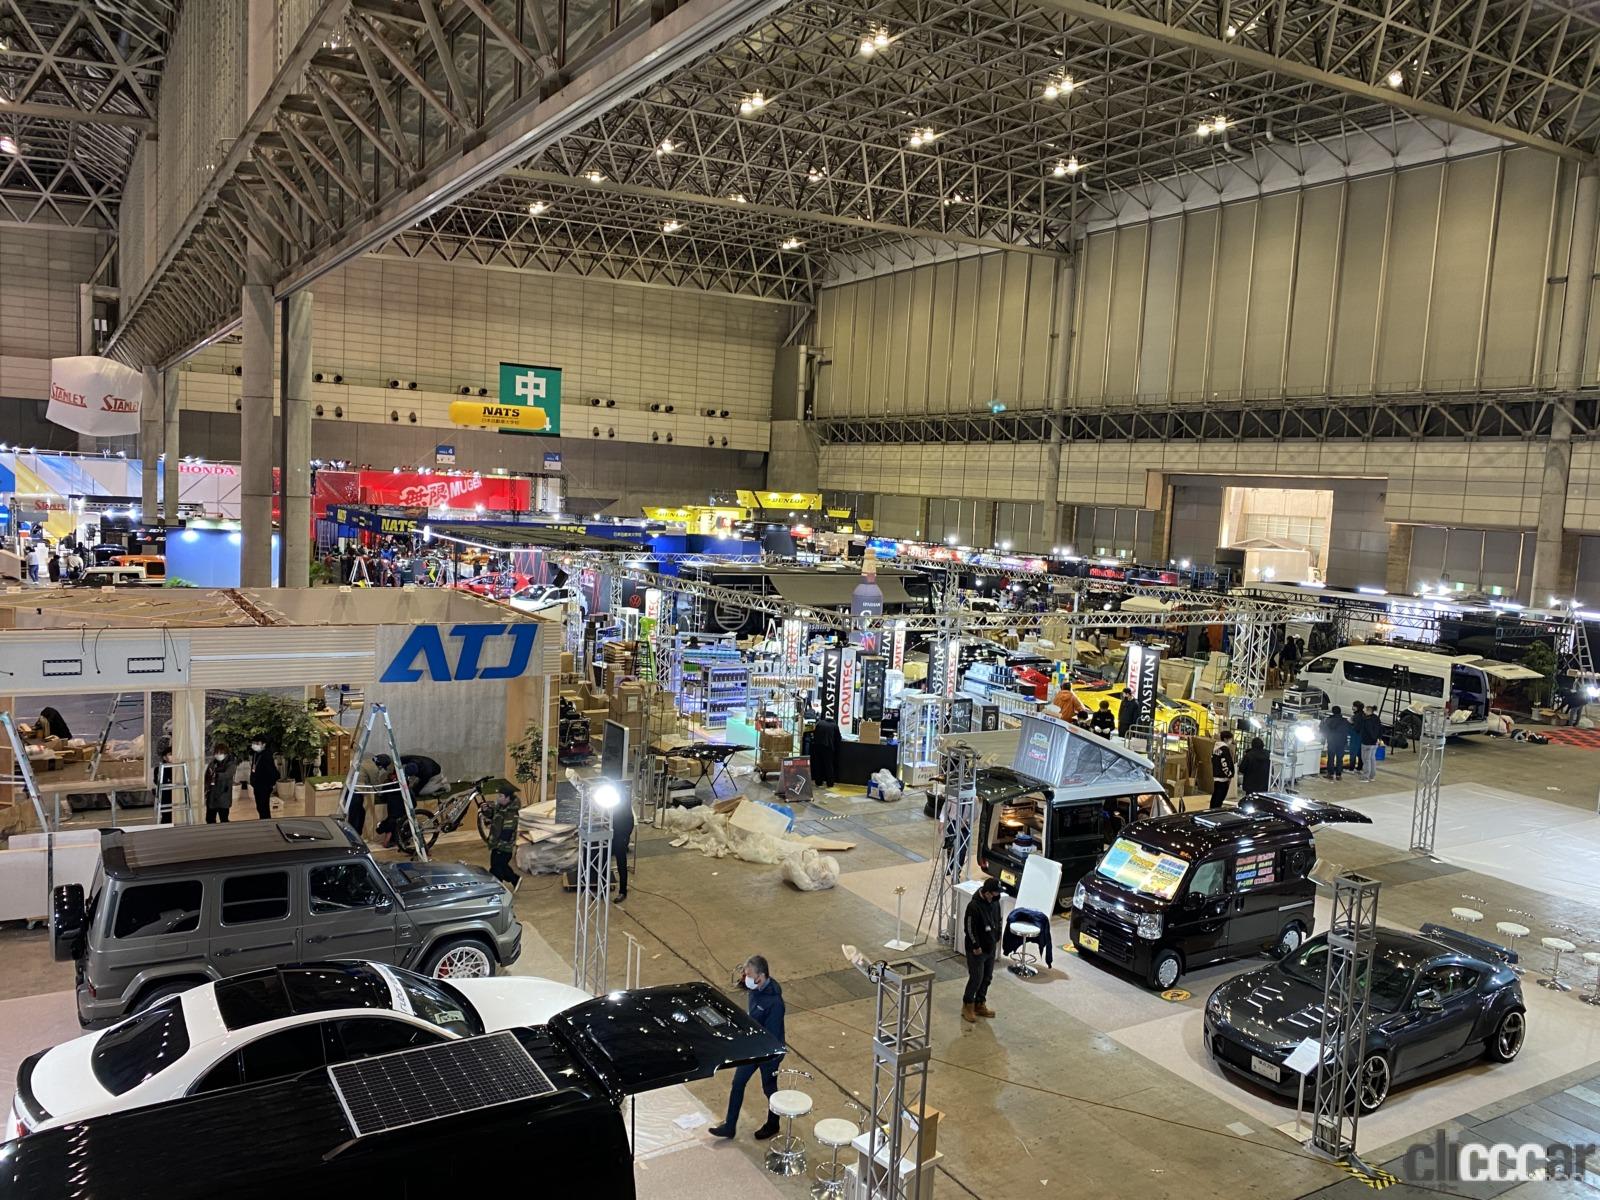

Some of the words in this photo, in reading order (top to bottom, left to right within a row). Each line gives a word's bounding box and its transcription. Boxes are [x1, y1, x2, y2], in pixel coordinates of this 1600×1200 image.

[51, 382, 87, 408] STANLEY
[515, 371, 547, 406] 中
[101, 394, 139, 412] STANLE
[482, 406, 520, 417] NATS
[179, 465, 236, 475] HONDA
[381, 518, 418, 532] NATS
[379, 624, 539, 682] ATJ
[1140, 654, 1157, 723] SPASHAN
